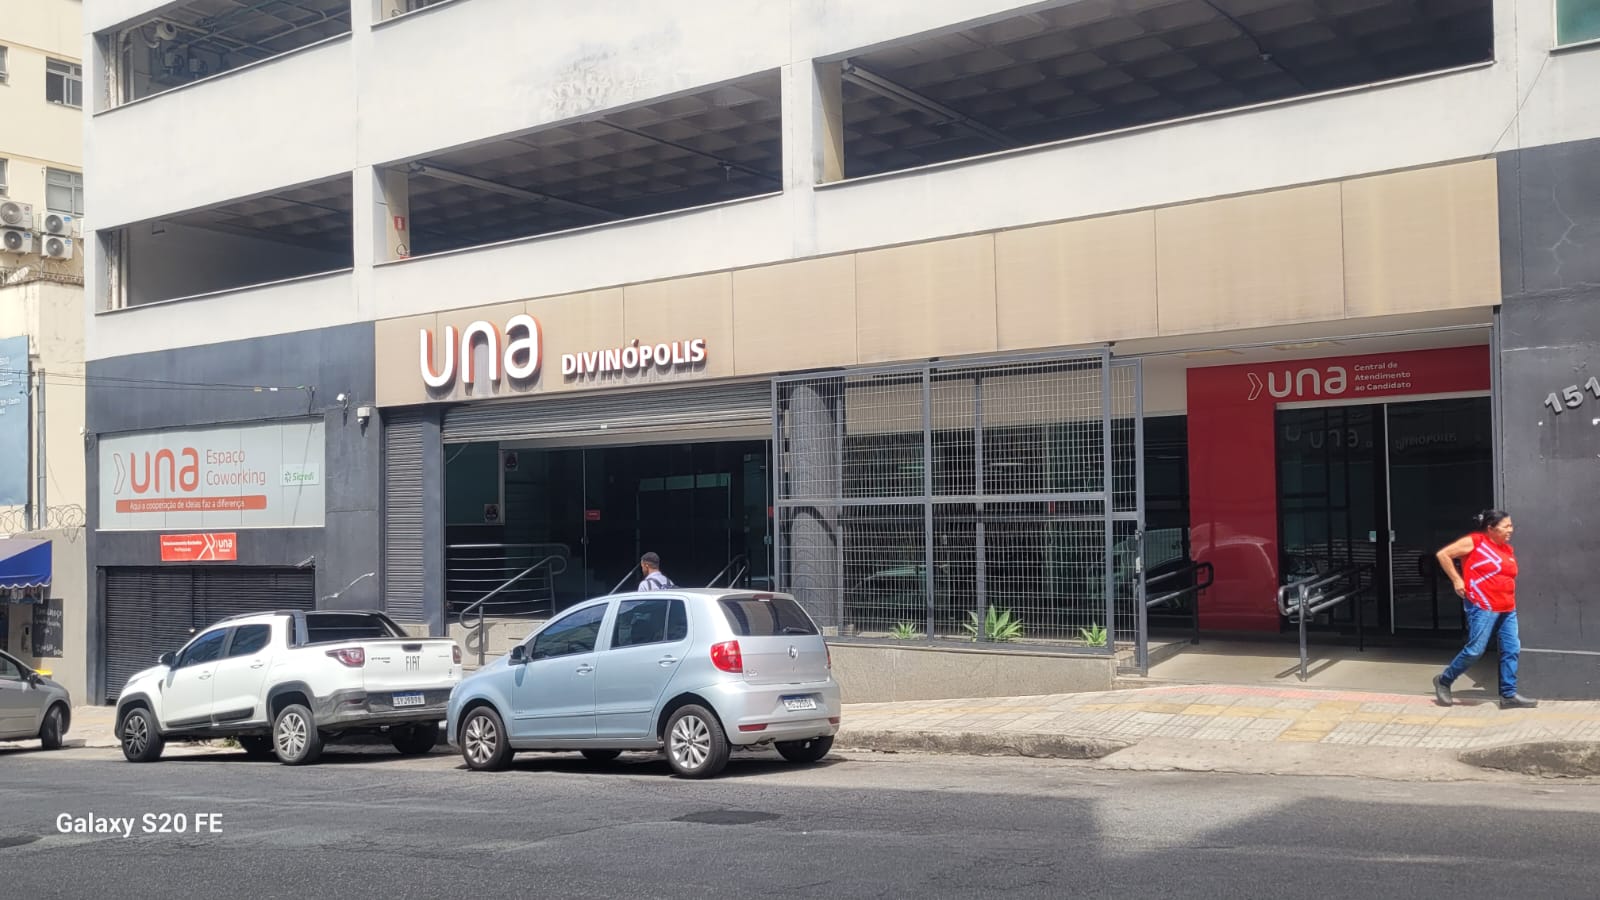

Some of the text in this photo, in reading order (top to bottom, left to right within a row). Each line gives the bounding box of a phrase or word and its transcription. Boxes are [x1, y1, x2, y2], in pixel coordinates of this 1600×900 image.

[419, 313, 542, 387] una
[561, 339, 706, 376] DIVINÓPOLIS
[1354, 361, 1398, 372] Central de
[1268, 366, 1347, 398] una
[1354, 371, 1411, 381] Atendimento
[1366, 381, 1411, 391] Candidato
[206, 449, 245, 464] Espaço
[130, 447, 199, 494] una
[206, 469, 266, 486] Coworking
[405, 656, 420, 672] FIAT
